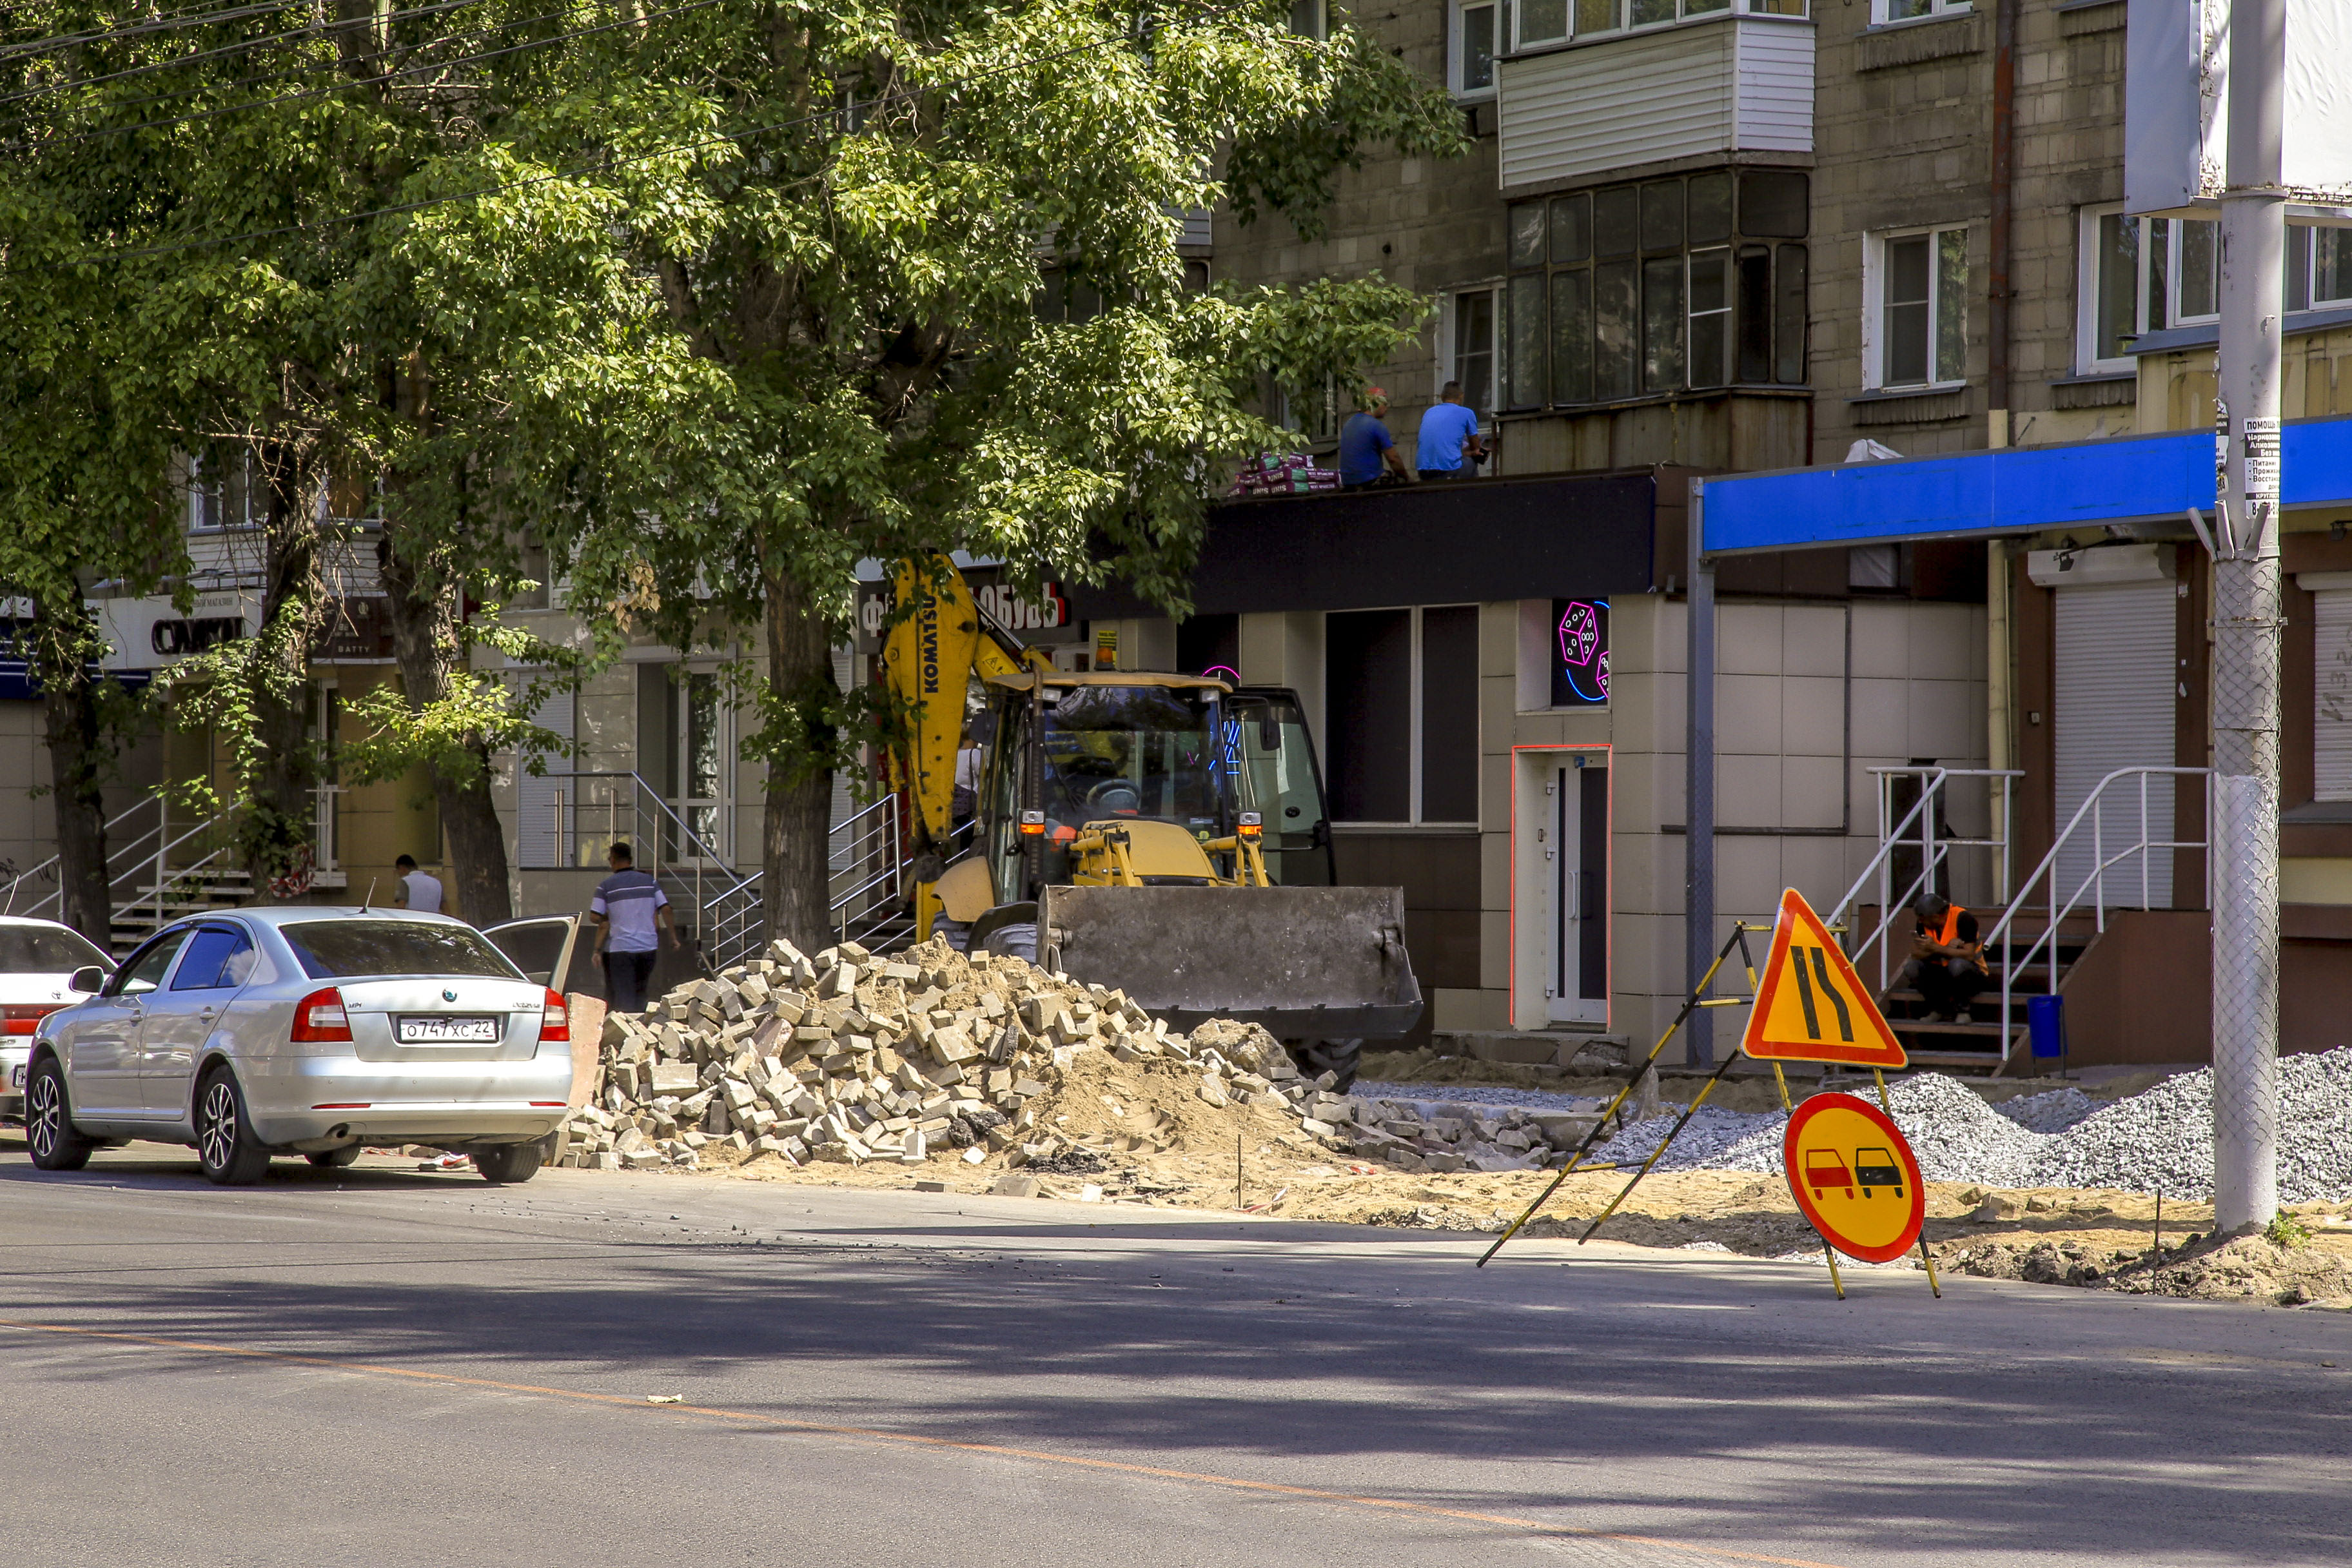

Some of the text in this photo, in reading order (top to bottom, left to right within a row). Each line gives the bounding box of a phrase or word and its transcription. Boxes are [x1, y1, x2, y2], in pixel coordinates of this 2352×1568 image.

[2247, 421, 2276, 430] ПОМОЩЬ
[923, 595, 939, 693] KOMATSU
[475, 1021, 489, 1033] 22
